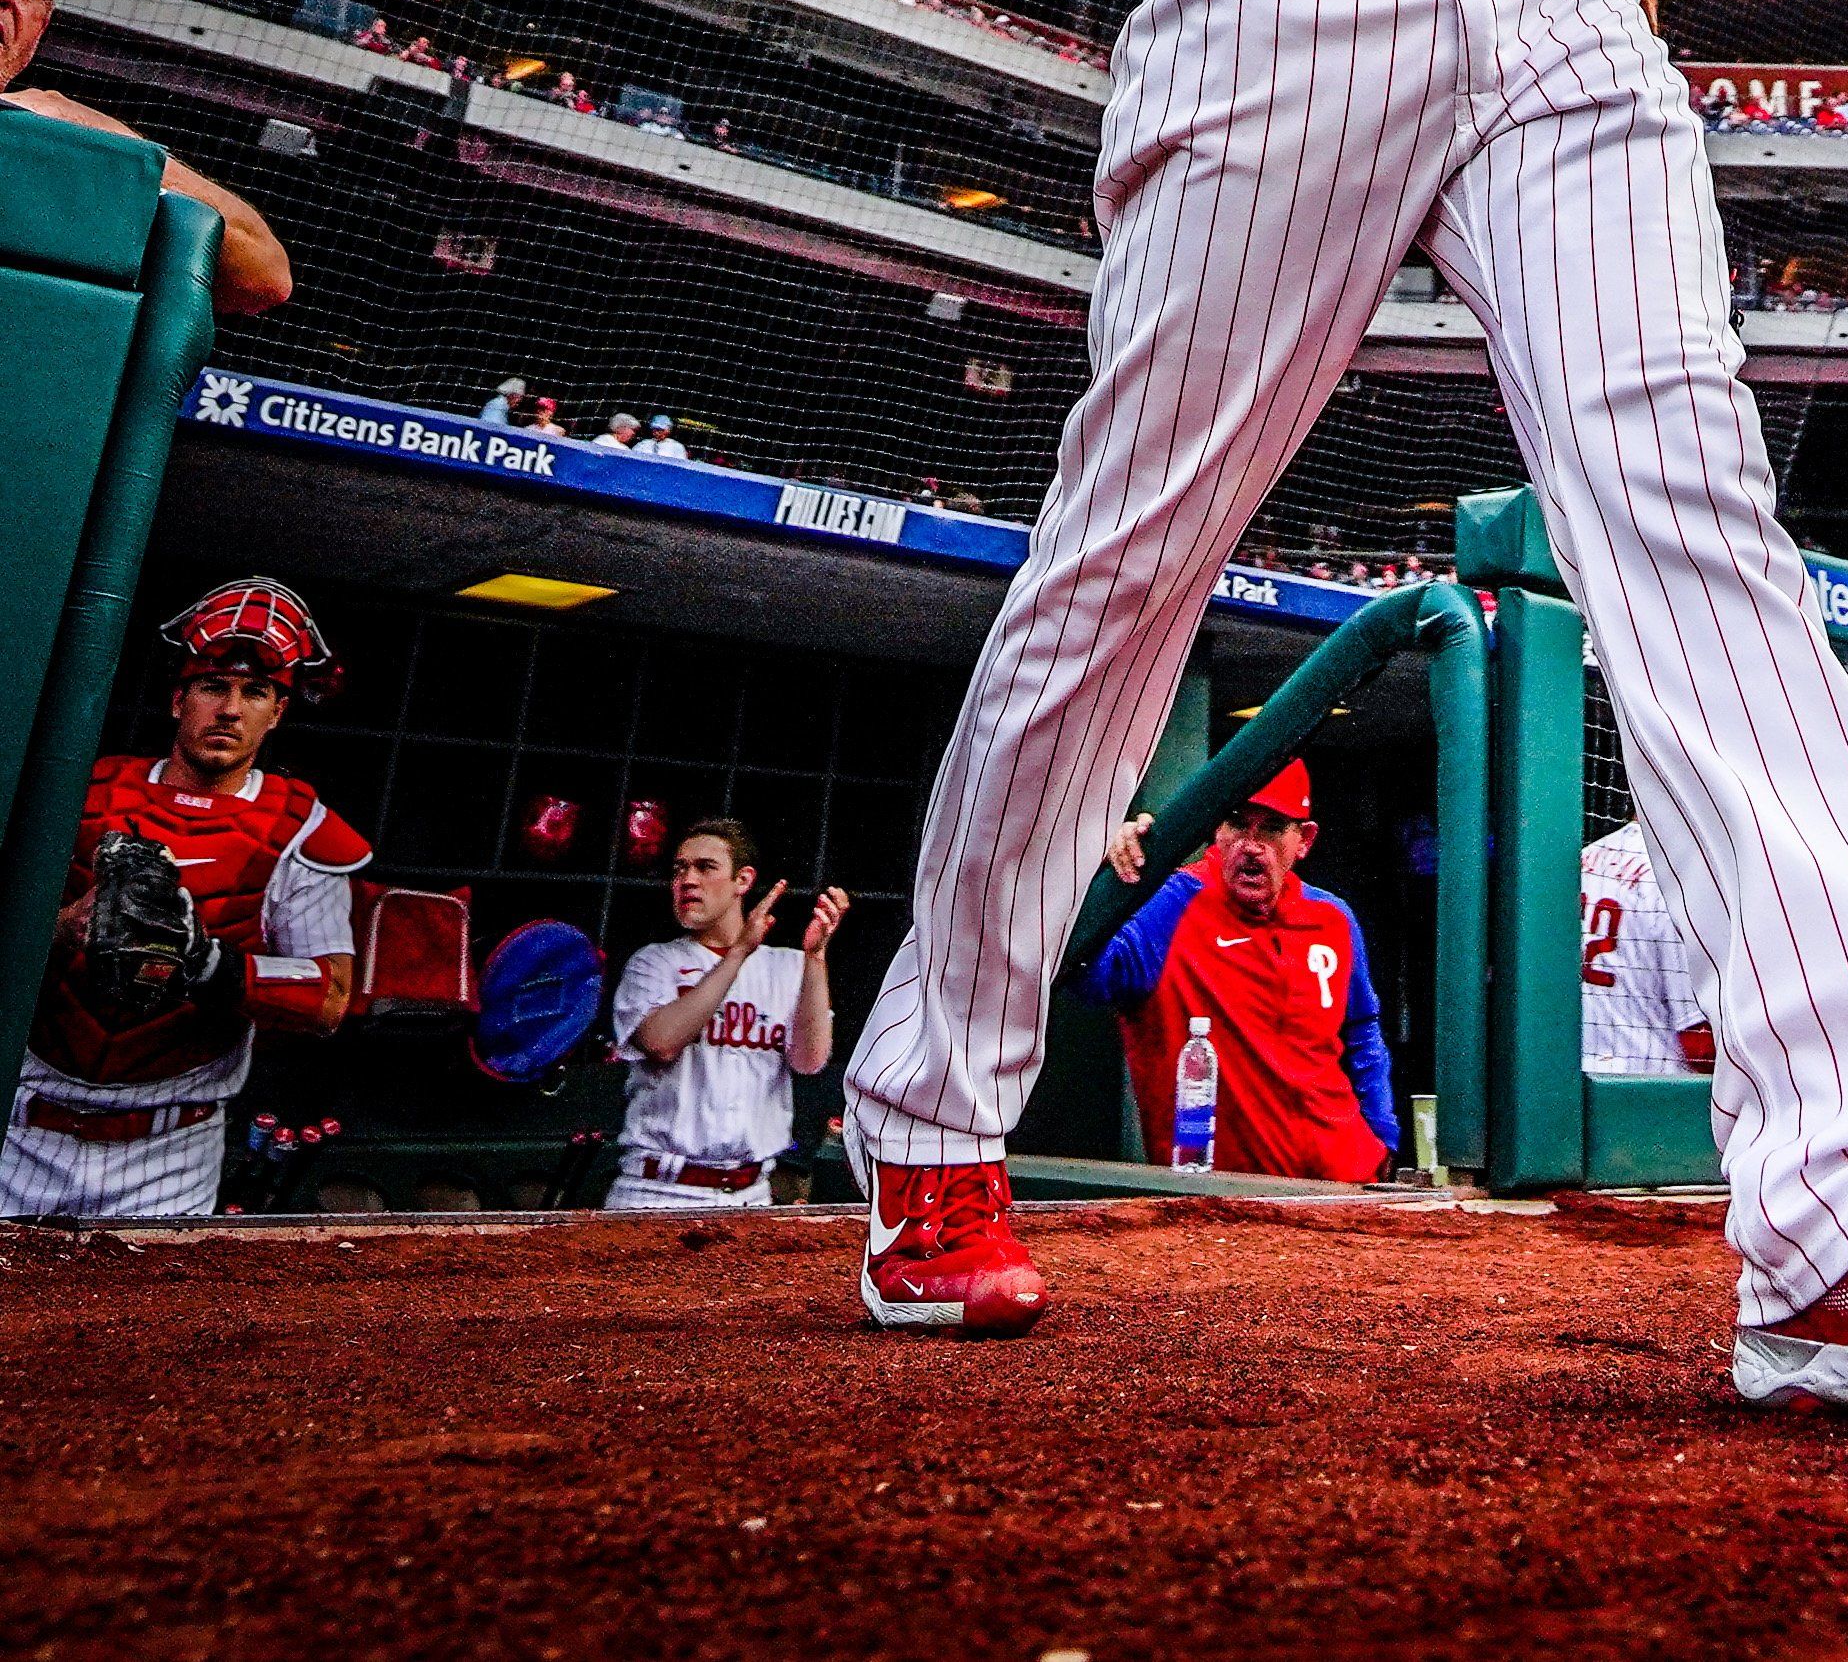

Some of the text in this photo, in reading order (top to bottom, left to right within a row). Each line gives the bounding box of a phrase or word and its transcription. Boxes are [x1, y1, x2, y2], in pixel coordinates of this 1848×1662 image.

[259, 394, 556, 477] Citizens Bank Park
[1231, 576, 1279, 607] Park
[1581, 893, 1623, 988] 2
